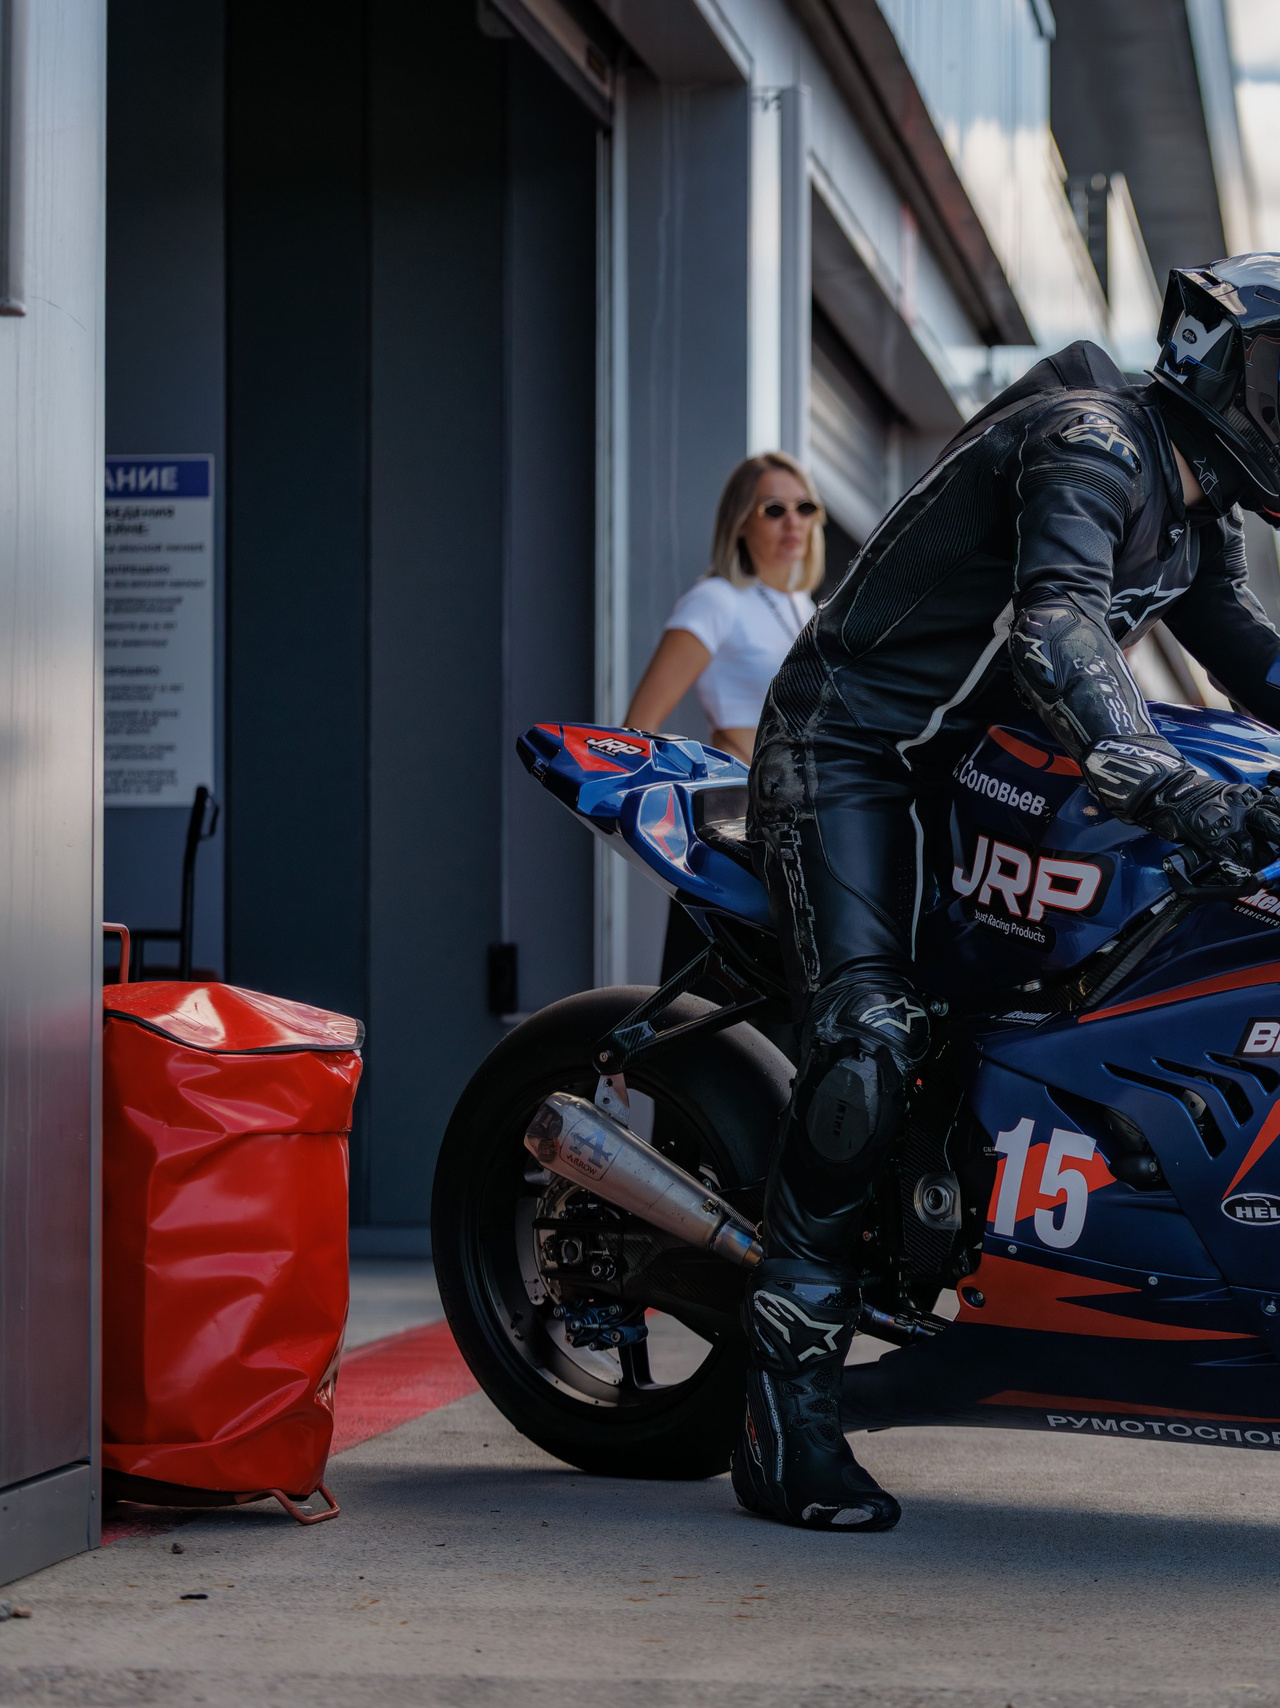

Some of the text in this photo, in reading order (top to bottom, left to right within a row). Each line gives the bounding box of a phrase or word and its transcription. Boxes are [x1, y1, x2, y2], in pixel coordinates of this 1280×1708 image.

[586, 737, 643, 755] JRP
[959, 759, 1046, 816] Соловьев
[952, 834, 1102, 923] JRP
[975, 908, 1046, 944] Just Racing Products
[1233, 905, 1280, 927] LUBRICANTS
[566, 1154, 598, 1175] ARROW
[993, 1117, 1098, 1249] 15
